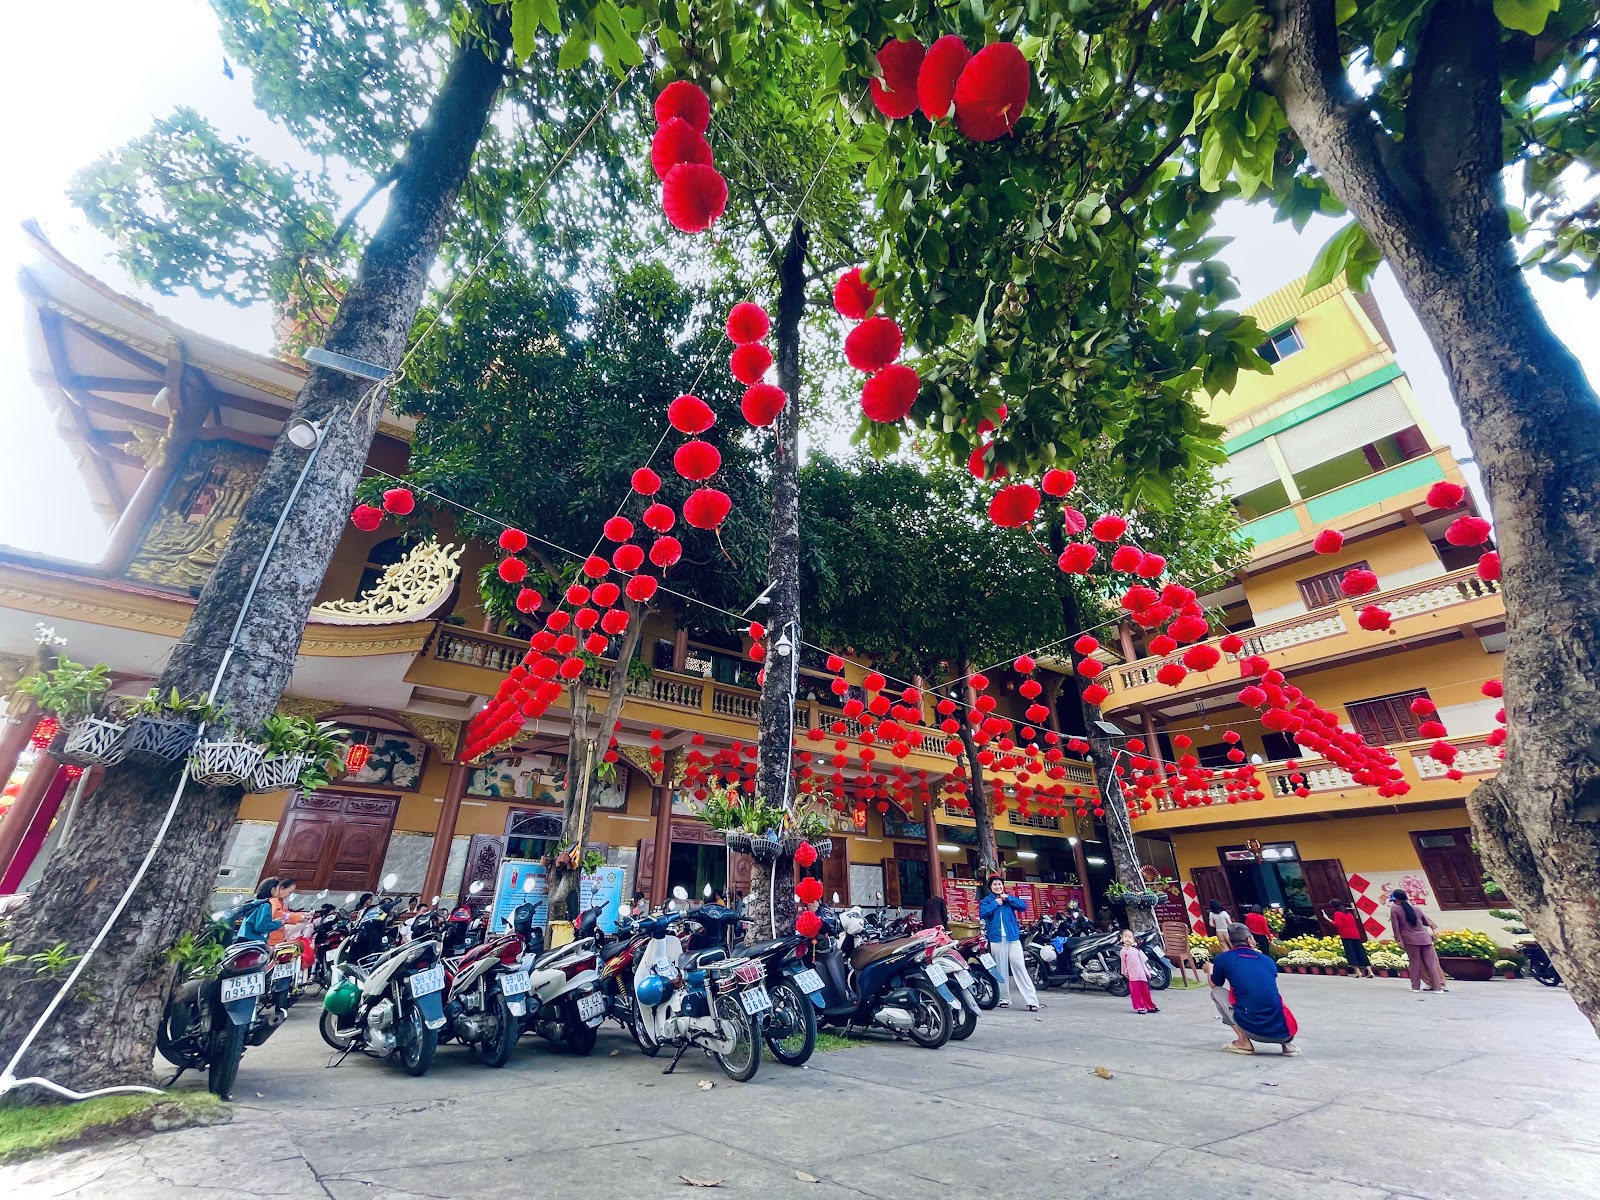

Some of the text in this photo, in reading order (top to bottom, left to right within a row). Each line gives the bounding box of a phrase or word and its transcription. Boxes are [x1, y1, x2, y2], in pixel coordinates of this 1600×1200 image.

[230, 974, 258, 988] 76-K1
[415, 970, 438, 984] 59-P2
[224, 984, 262, 1000] 095.21
